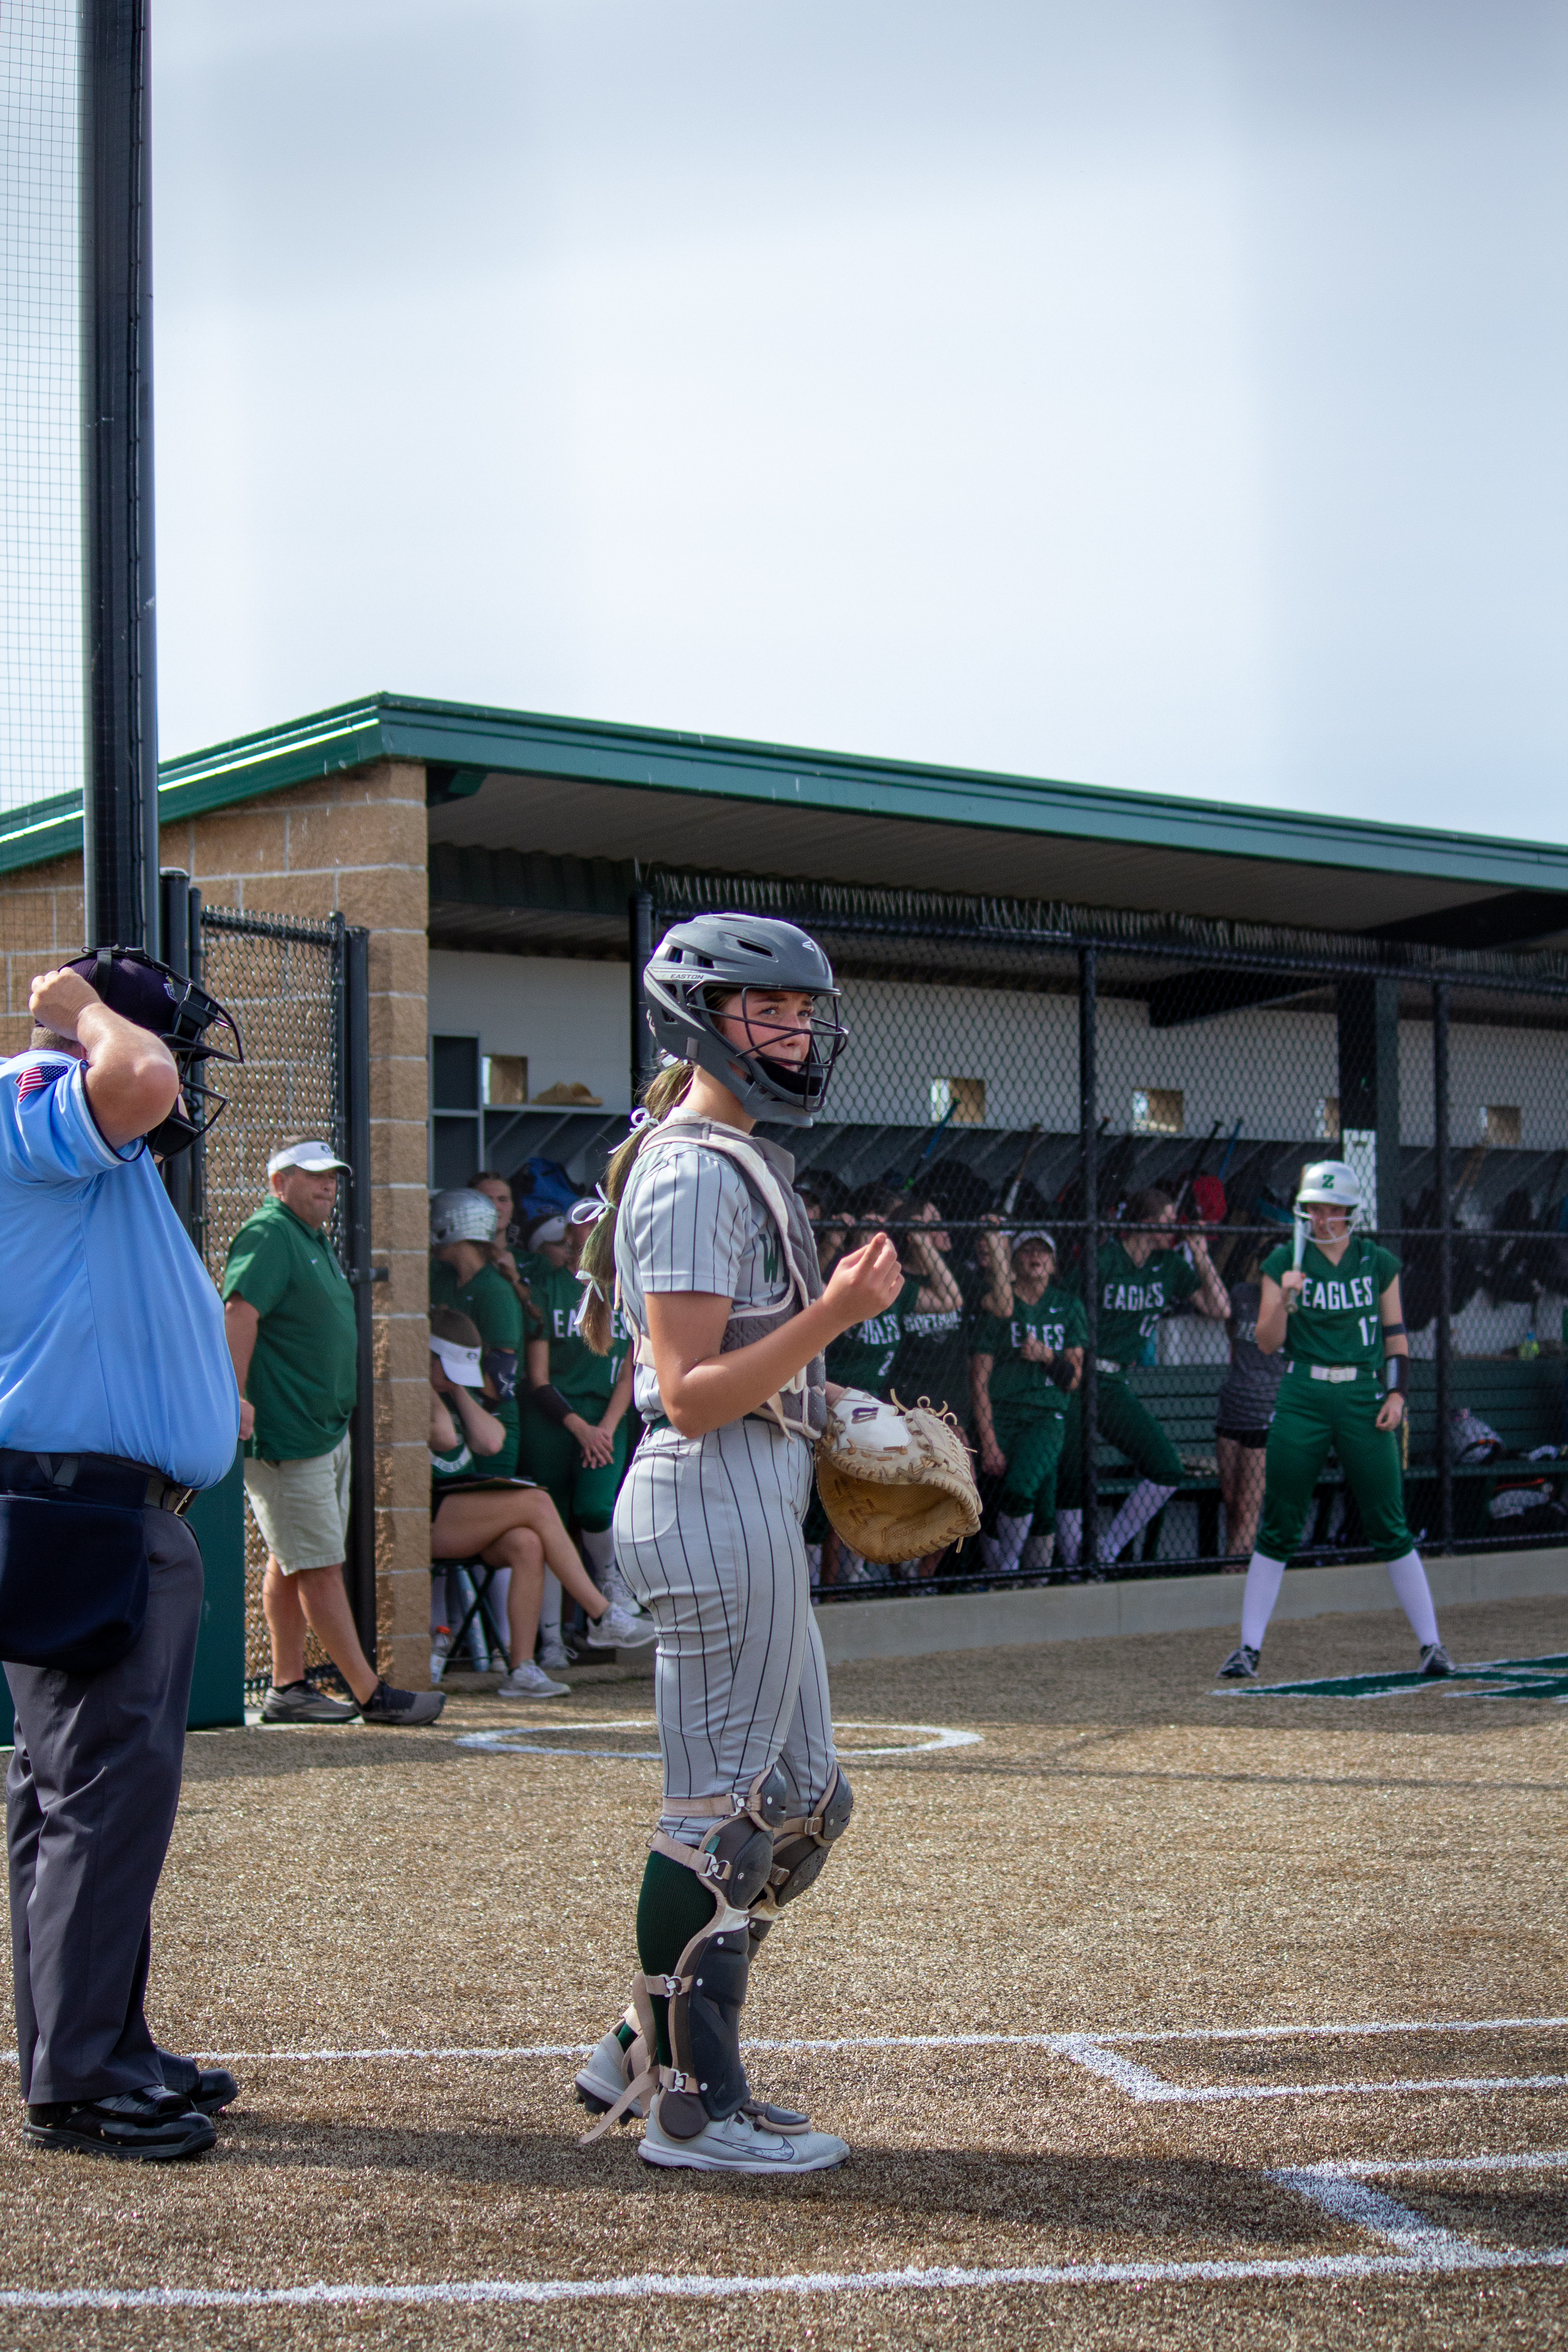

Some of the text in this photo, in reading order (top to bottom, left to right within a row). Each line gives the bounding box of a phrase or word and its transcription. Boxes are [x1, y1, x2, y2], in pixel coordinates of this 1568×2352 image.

[1322, 1174, 1335, 1189] Z
[1302, 1276, 1373, 1310] EAGLES
[554, 1309, 627, 1340] EAES
[1358, 1315, 1378, 1346] 17
[892, 1522, 927, 1539] CONTROL
